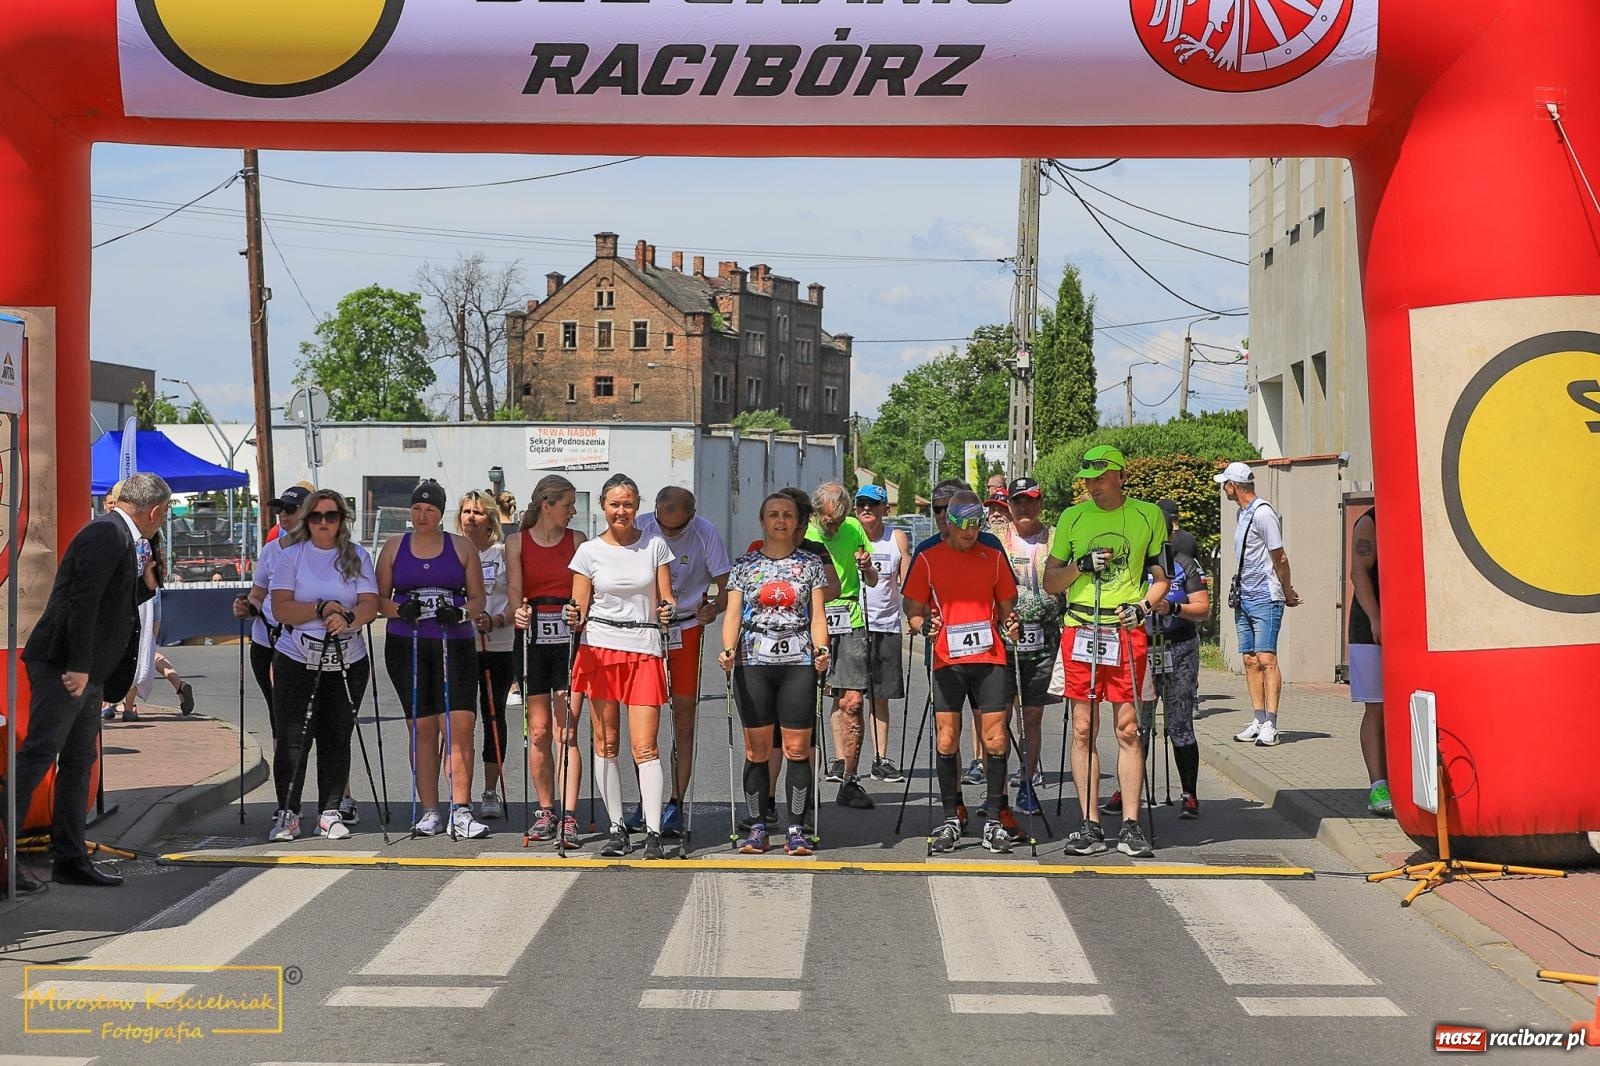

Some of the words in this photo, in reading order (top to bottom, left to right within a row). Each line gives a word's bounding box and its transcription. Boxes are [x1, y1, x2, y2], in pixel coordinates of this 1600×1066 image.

[521, 28, 985, 97] RACIBÓRZ
[538, 427, 564, 437] TRWA
[529, 437, 556, 446] Sekcja
[558, 437, 606, 446] Podnoszenia
[827, 614, 841, 626] 47
[542, 622, 559, 635] 51
[963, 632, 981, 646] 41
[770, 640, 789, 654] 49
[1086, 641, 1107, 656] 55
